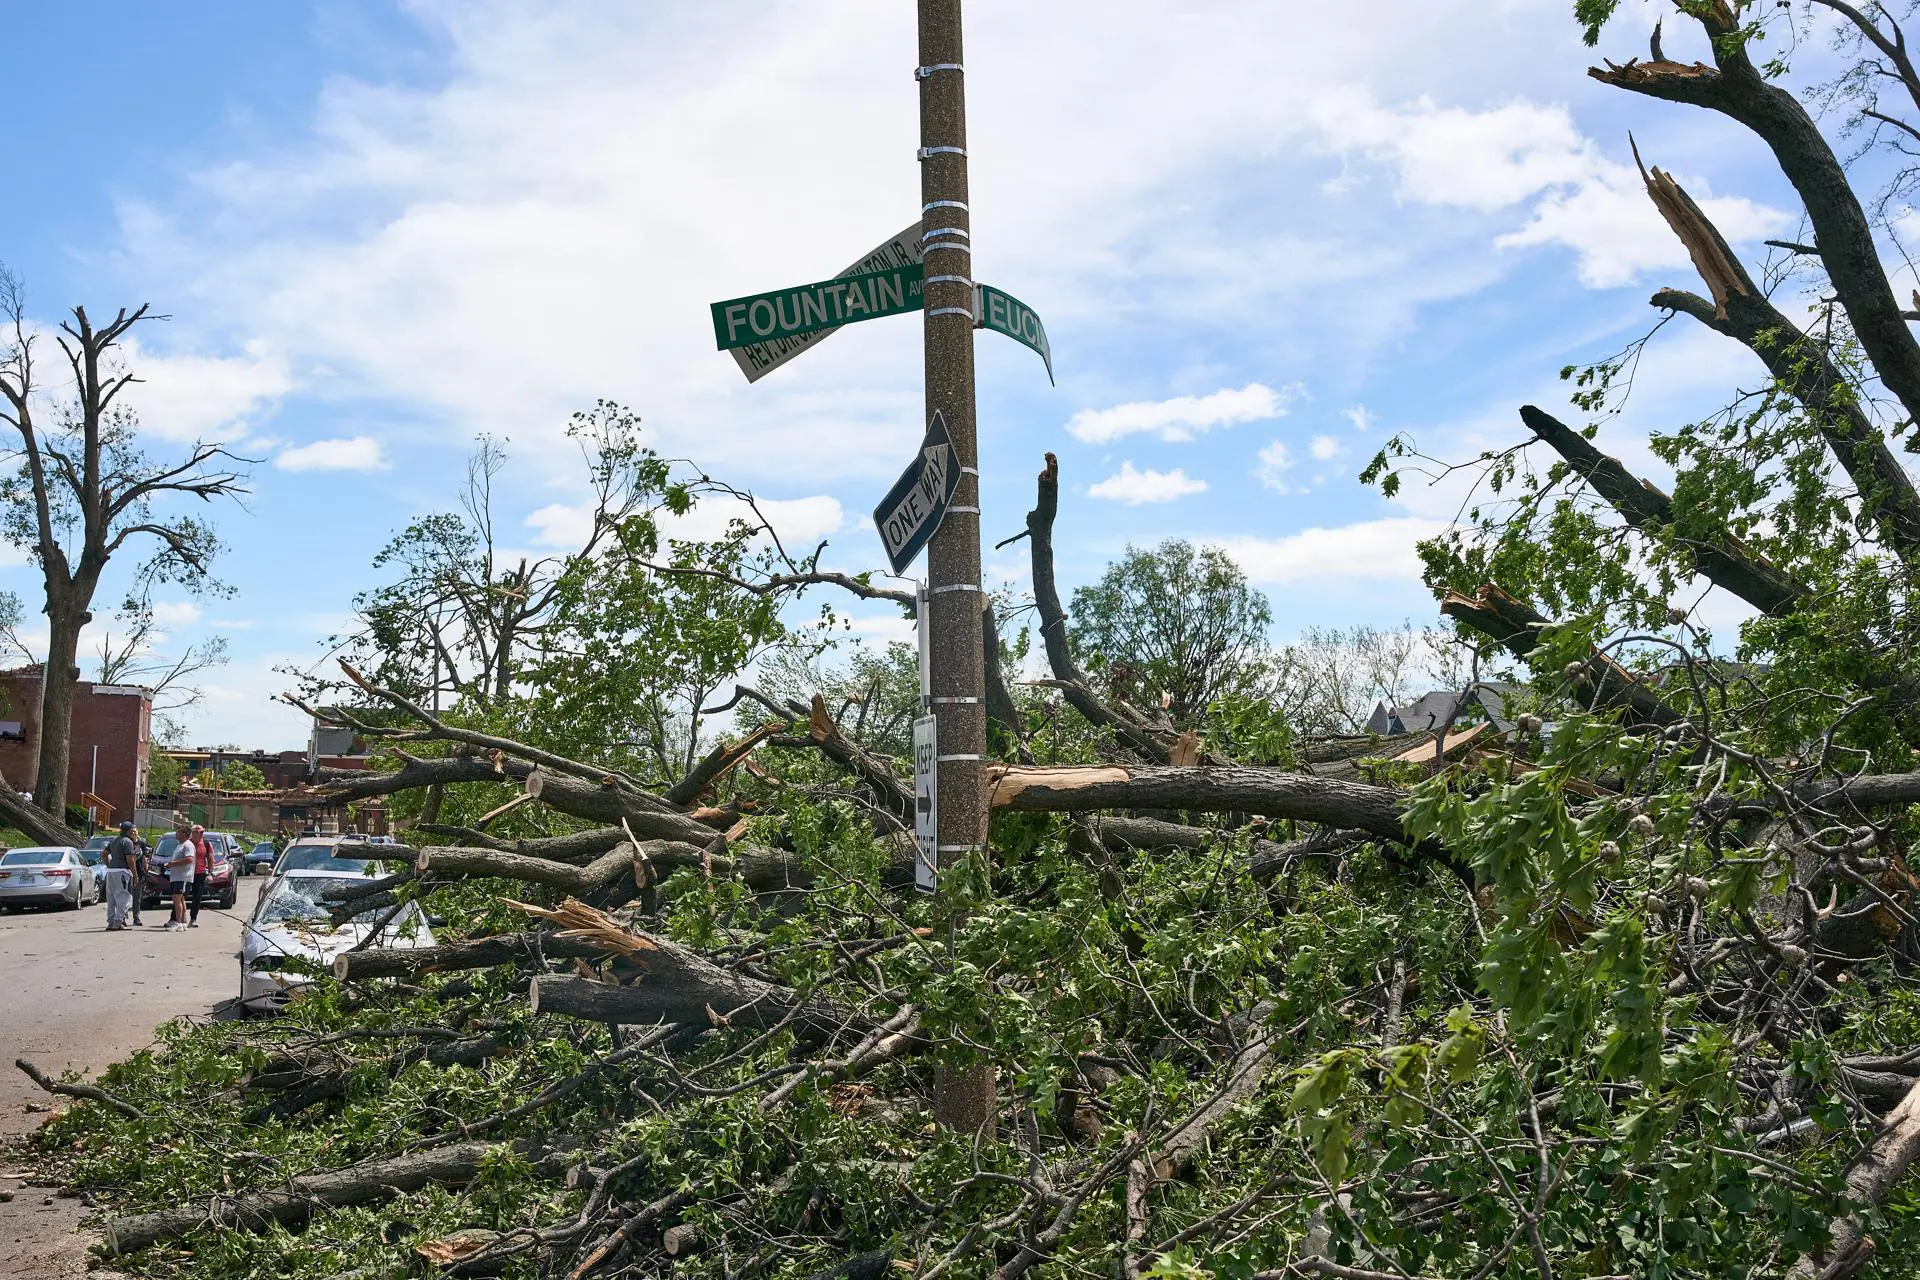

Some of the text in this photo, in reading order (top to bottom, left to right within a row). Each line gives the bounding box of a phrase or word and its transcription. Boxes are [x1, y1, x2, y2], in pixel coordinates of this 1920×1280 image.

[725, 273, 905, 341] FOUNTAIN
[888, 449, 945, 547] ONE WAY
[916, 743, 933, 775] KEEP
